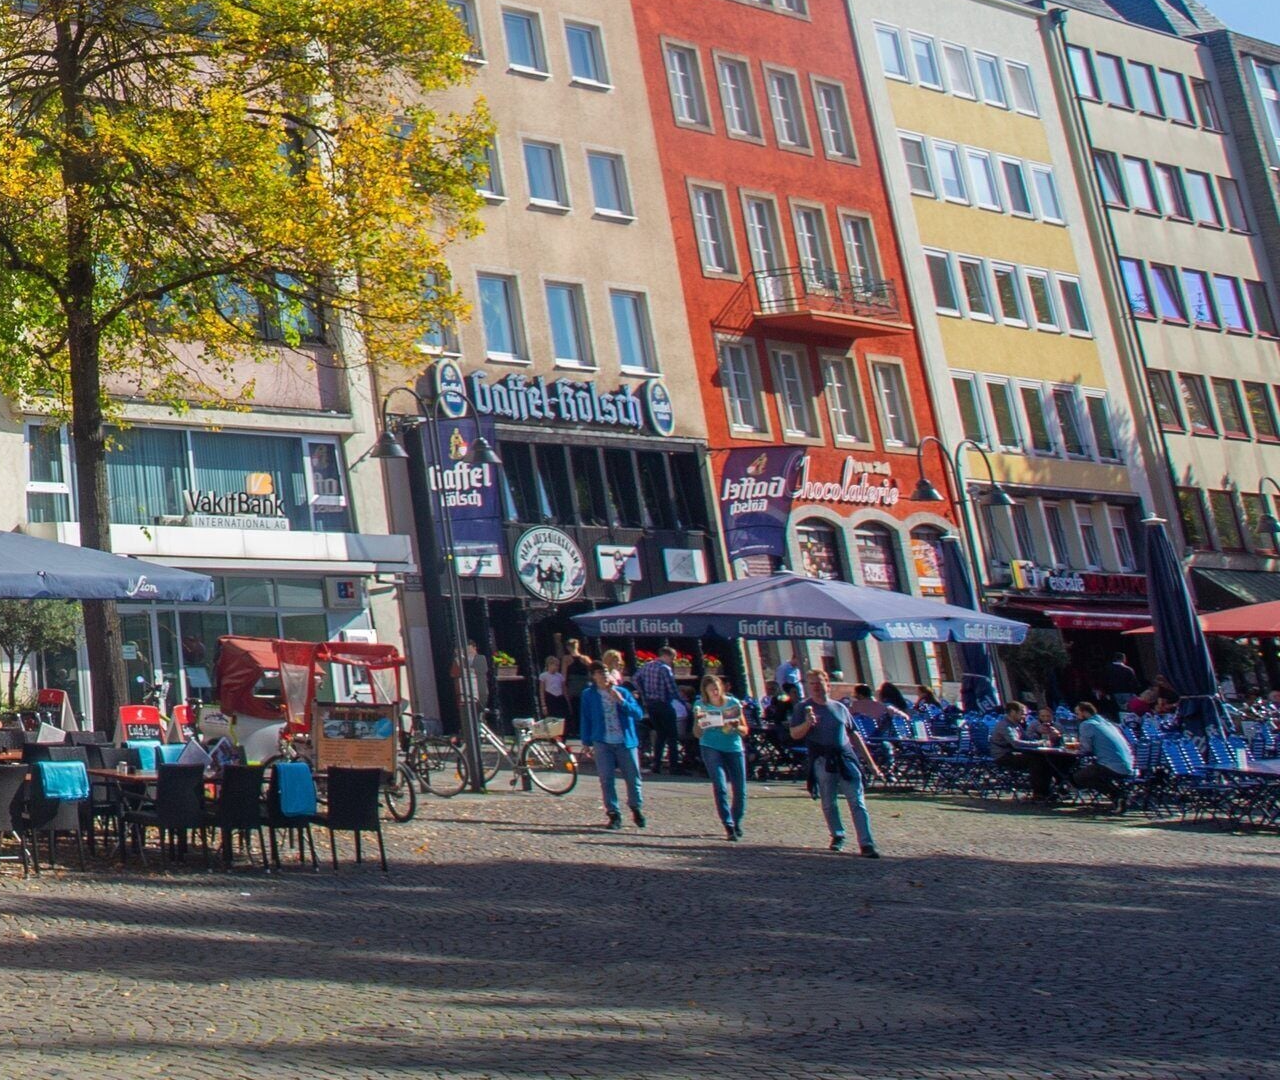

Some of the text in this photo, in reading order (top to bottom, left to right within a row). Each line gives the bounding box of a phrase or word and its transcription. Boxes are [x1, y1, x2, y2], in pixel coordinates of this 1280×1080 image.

[783, 450, 899, 505] Chocolaterie
[195, 517, 286, 530] INTERNATIONAL AG
[600, 619, 684, 635] Gaffel Kölsch
[739, 620, 833, 638] Gaffel Kölsch
